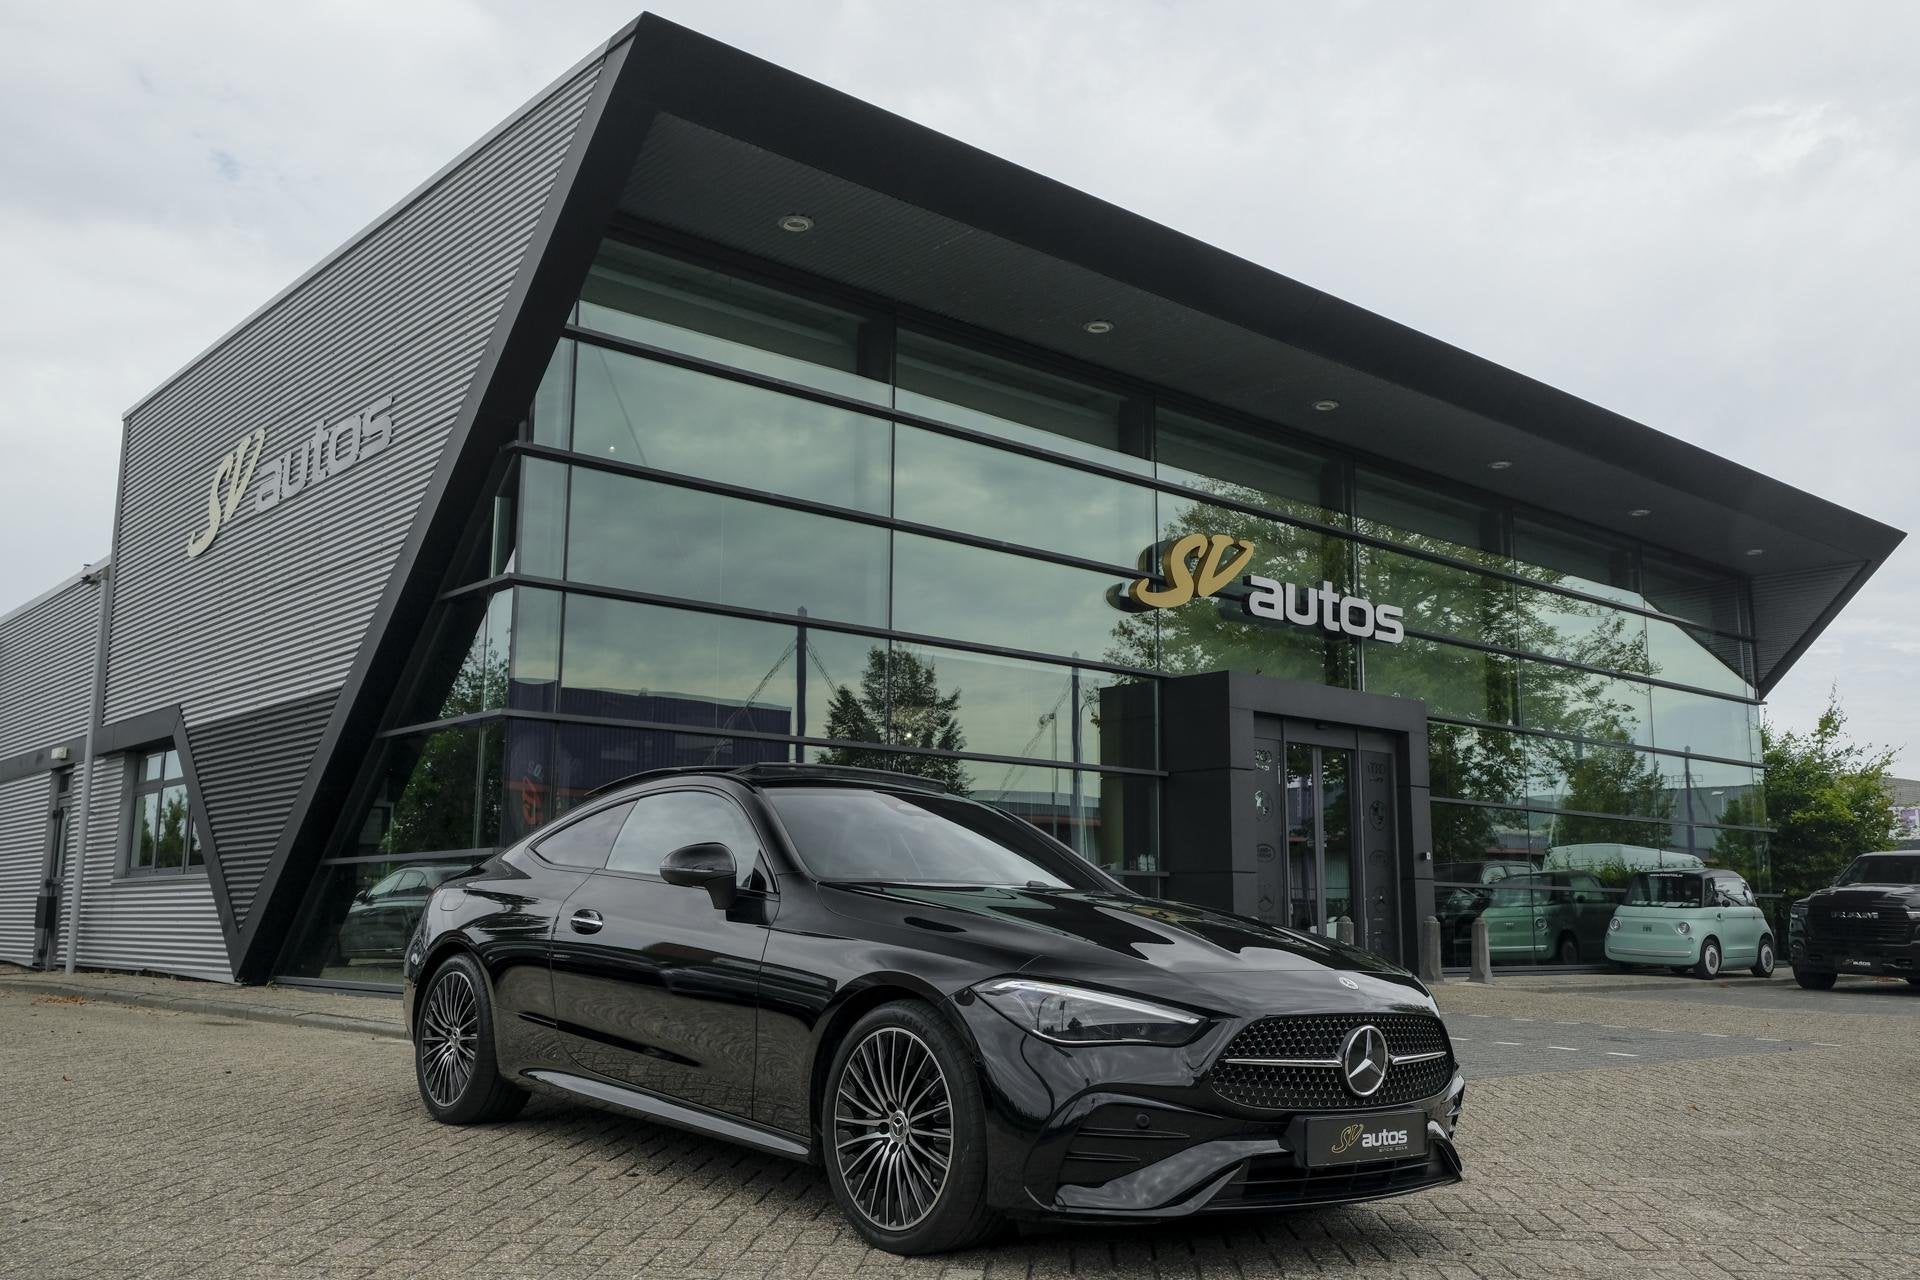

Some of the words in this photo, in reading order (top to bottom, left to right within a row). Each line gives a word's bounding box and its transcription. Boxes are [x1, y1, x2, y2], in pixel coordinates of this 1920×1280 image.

[188, 428, 266, 558] SV
[254, 393, 393, 513] autos
[1134, 533, 1254, 608] SV
[1249, 575, 1404, 644] autos
[1331, 1123, 1364, 1154] SV
[1361, 1128, 1408, 1148] autos
